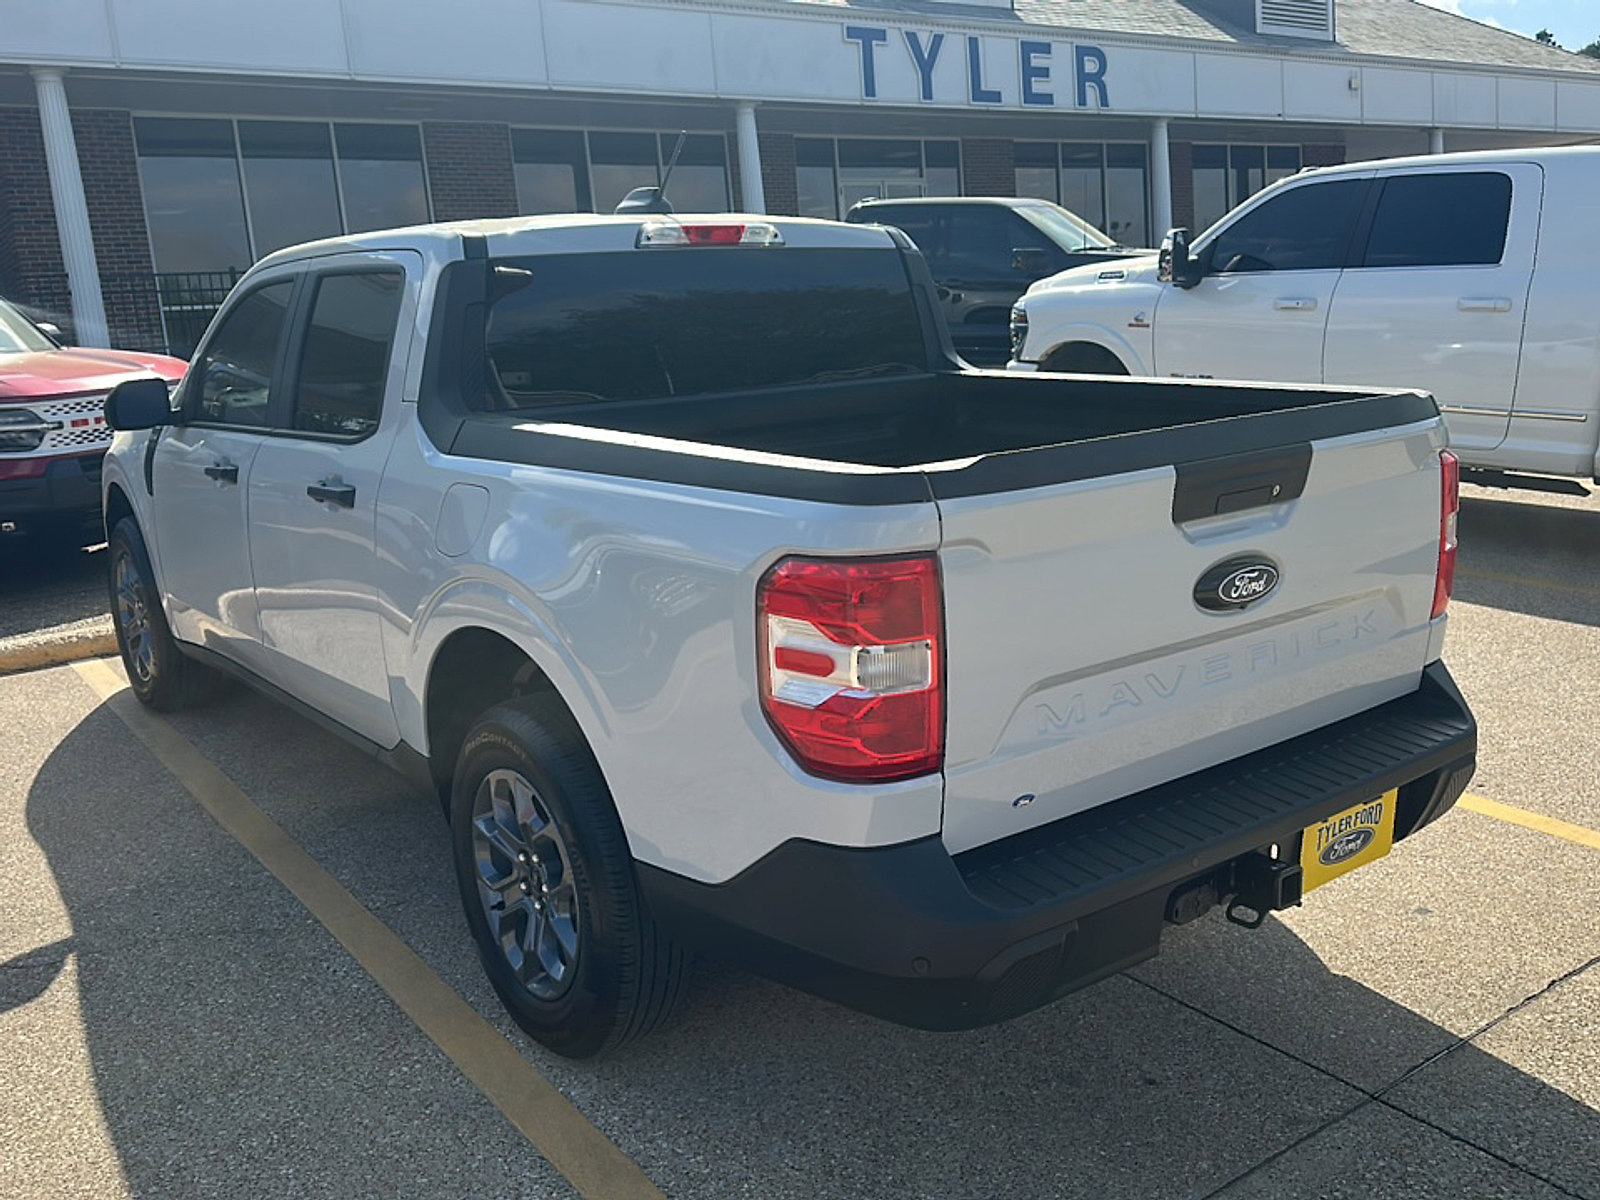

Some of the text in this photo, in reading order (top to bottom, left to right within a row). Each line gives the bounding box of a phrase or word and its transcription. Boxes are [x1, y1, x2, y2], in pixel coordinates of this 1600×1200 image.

[845, 26, 1110, 108] TYLER
[1231, 571, 1268, 598] Ford
[1034, 608, 1379, 737] MAVERICK
[1317, 803, 1383, 853] TYLER FORD
[1329, 833, 1365, 860] Ford
